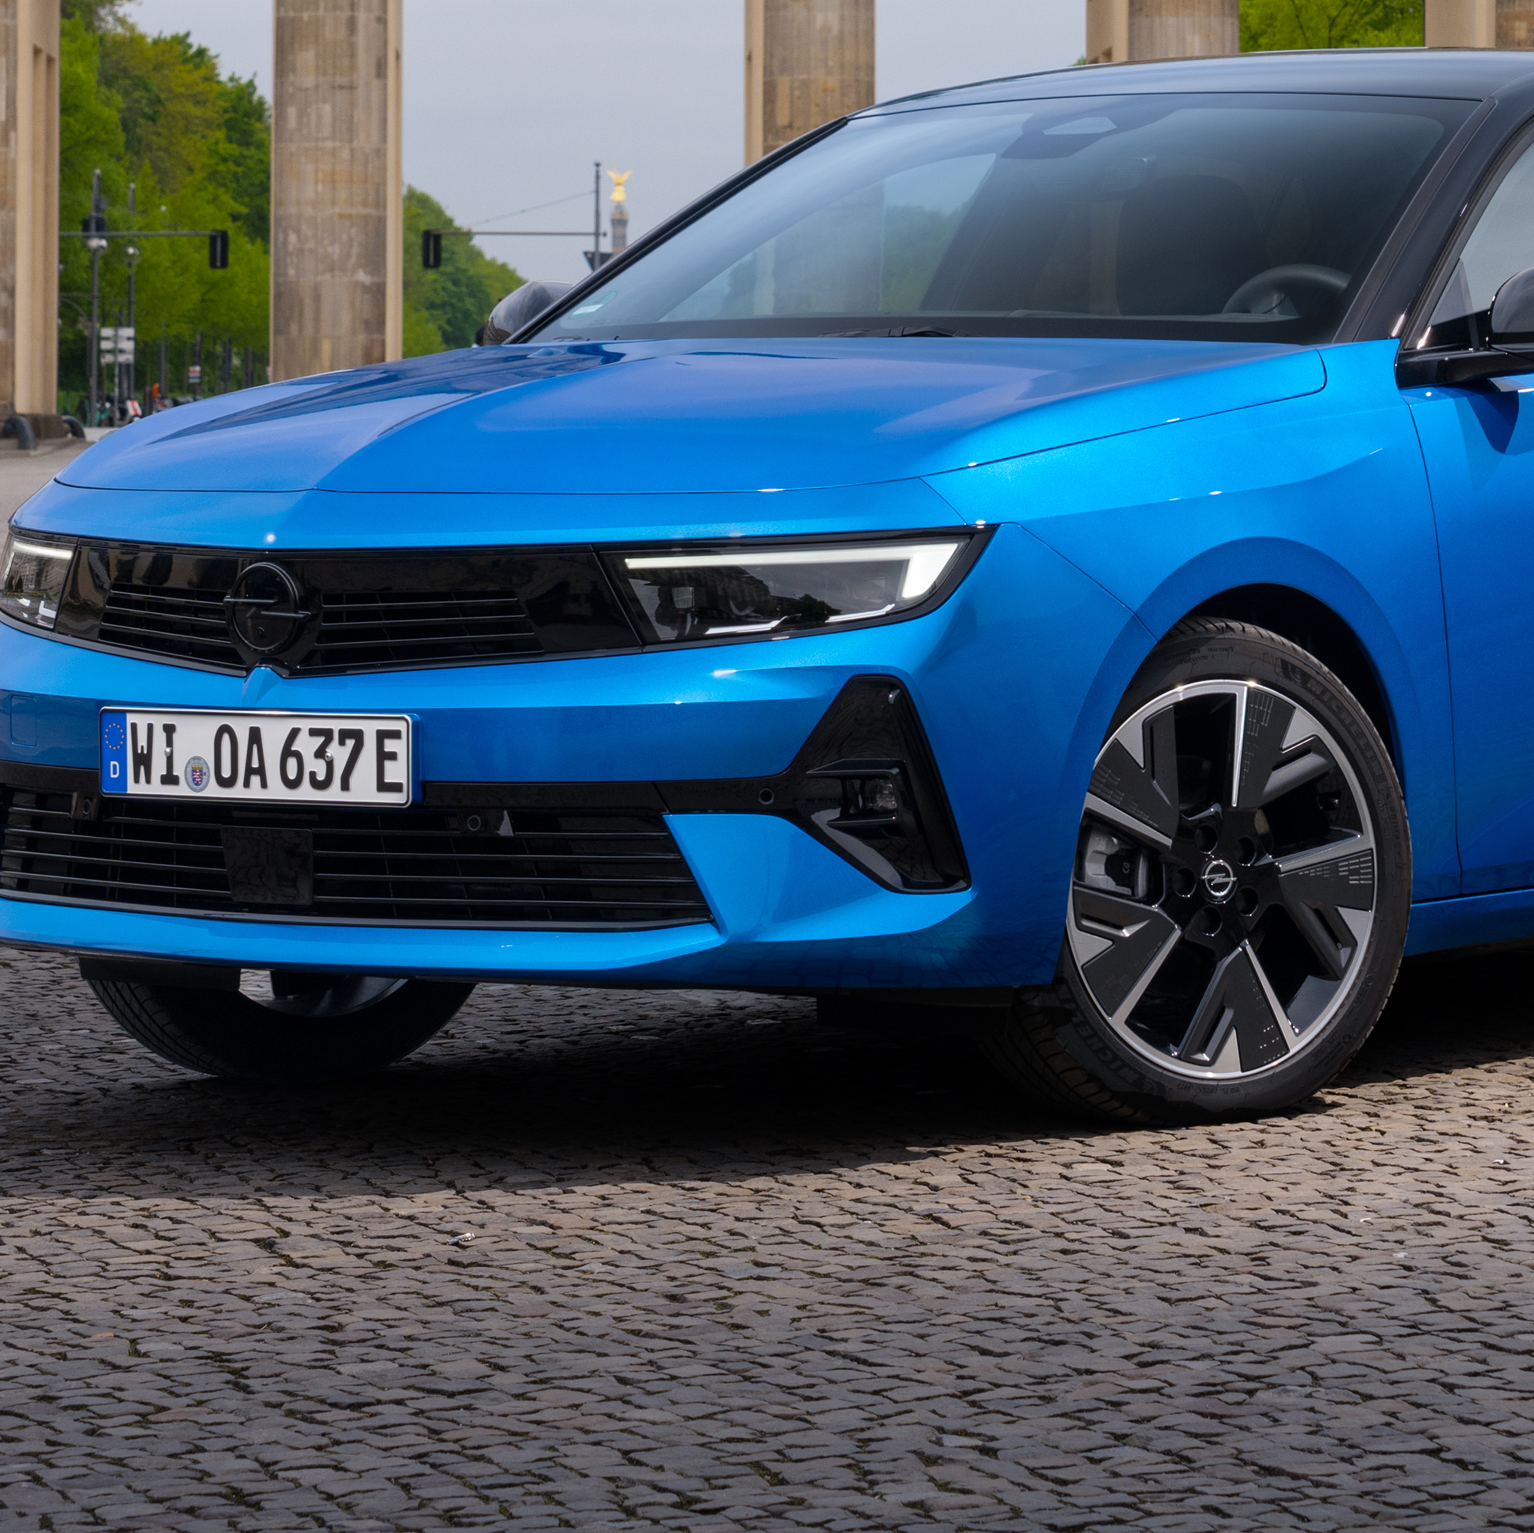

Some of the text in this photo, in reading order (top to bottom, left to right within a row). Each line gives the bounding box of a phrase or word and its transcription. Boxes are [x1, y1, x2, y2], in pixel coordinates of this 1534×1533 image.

[131, 722, 180, 786] WI
[1307, 676, 1385, 777] MICHELIN
[110, 761, 119, 778] D
